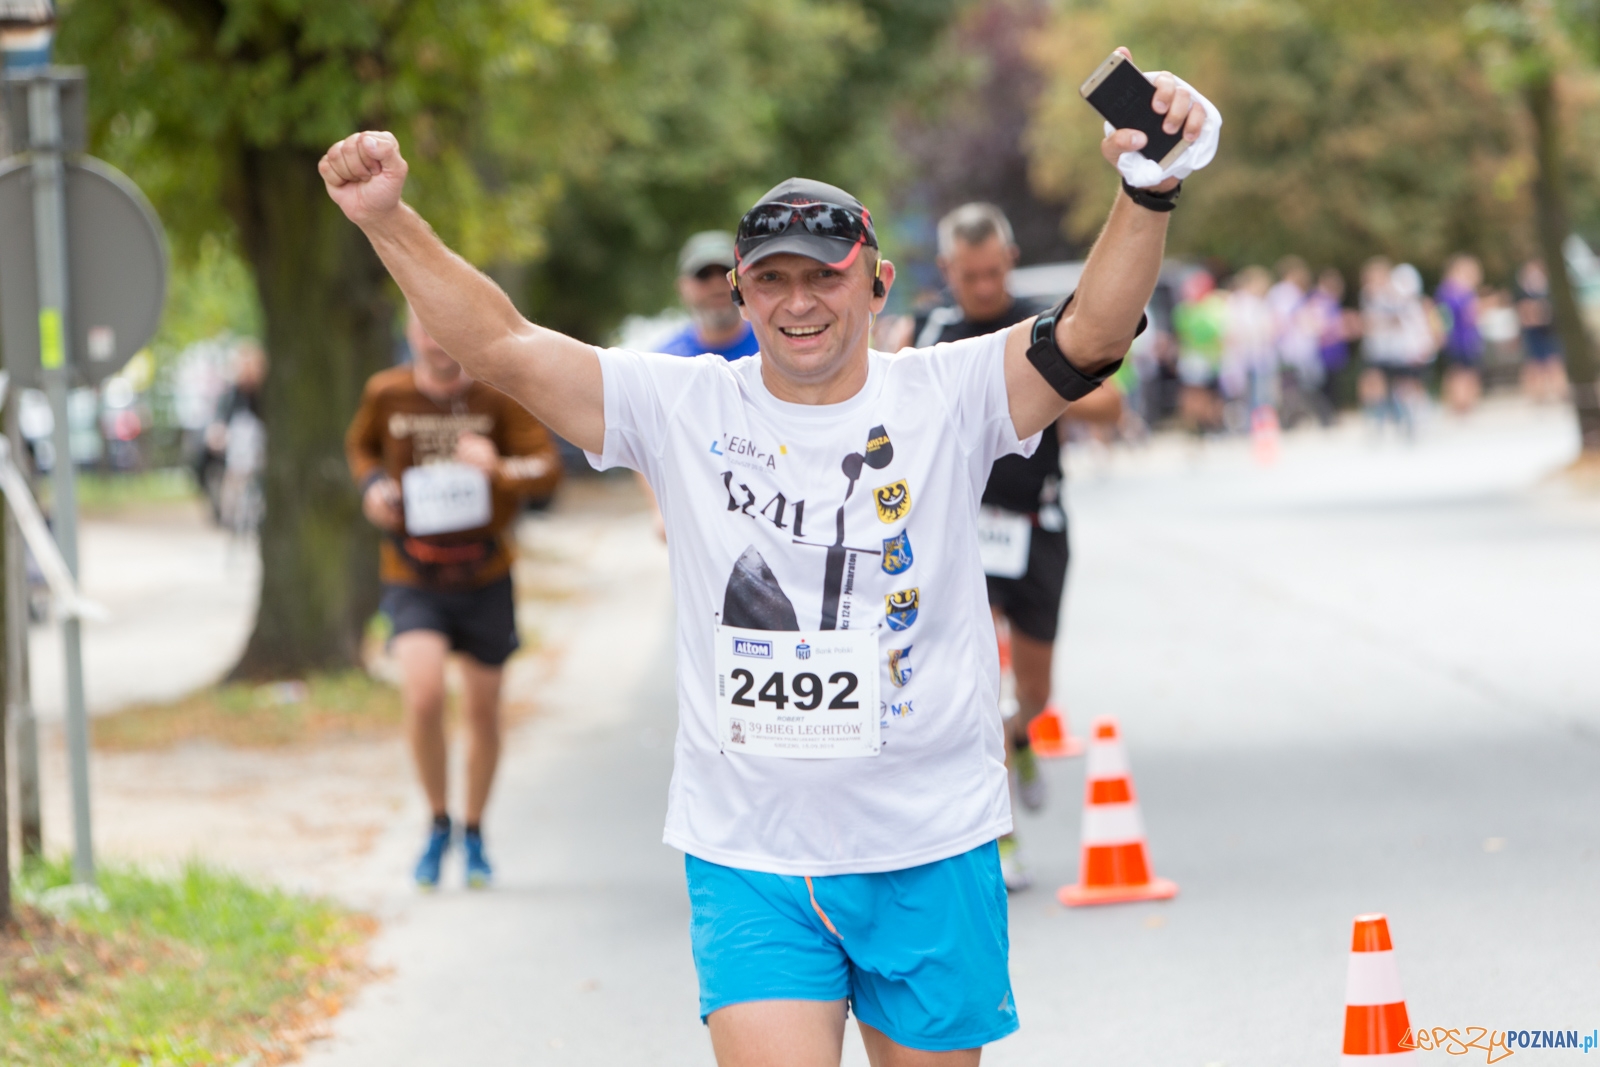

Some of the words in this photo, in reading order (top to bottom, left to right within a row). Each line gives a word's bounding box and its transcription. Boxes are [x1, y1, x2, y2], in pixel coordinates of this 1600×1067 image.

[730, 668, 860, 711] 2492
[748, 722, 762, 733] 39
[765, 724, 794, 735] BIEG
[798, 722, 863, 735] LECHITÓW
